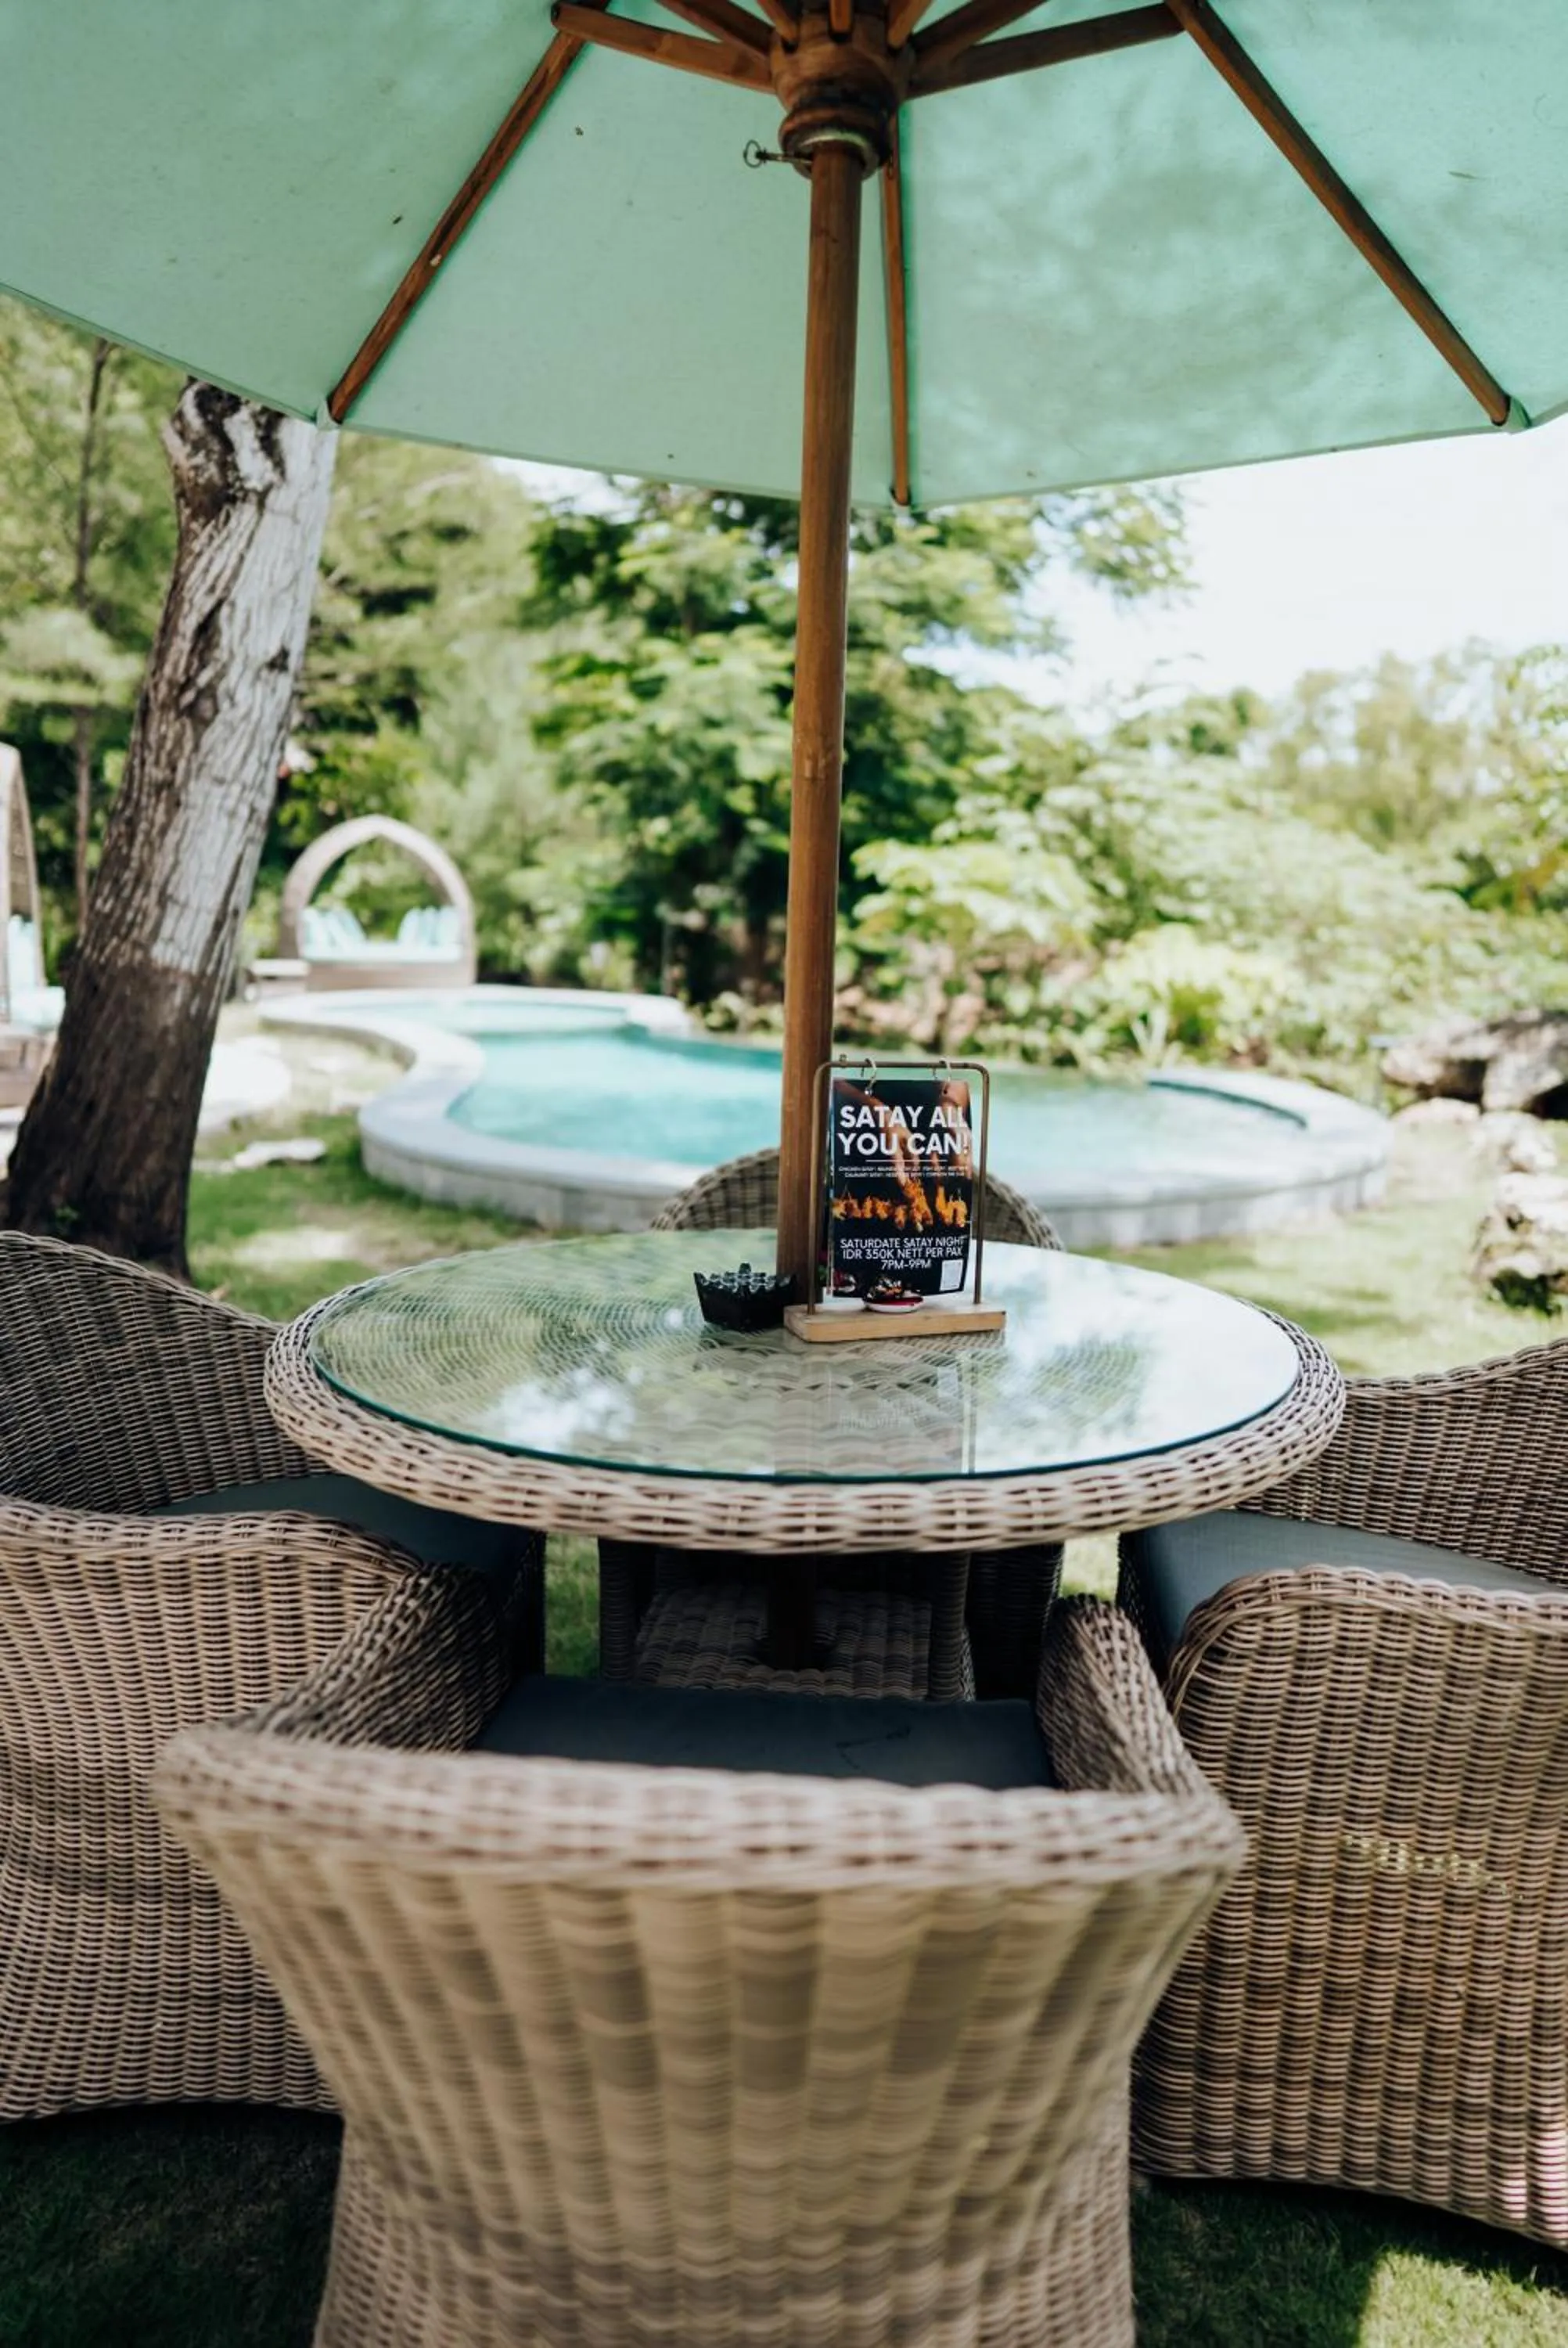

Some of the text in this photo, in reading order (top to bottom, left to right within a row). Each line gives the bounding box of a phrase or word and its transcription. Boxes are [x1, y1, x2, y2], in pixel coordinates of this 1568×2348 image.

[840, 1105, 968, 1128] SATAY ALL
[837, 1133, 969, 1155] YOU CAN!
[840, 1236, 967, 1249] SATURDATE SATAY NIGHT
[843, 1249, 862, 1259] IDR
[865, 1248, 894, 1259] 350K
[897, 1248, 923, 1259] NETT
[926, 1247, 943, 1258] PER
[881, 1259, 932, 1270] 7PM-9PM
